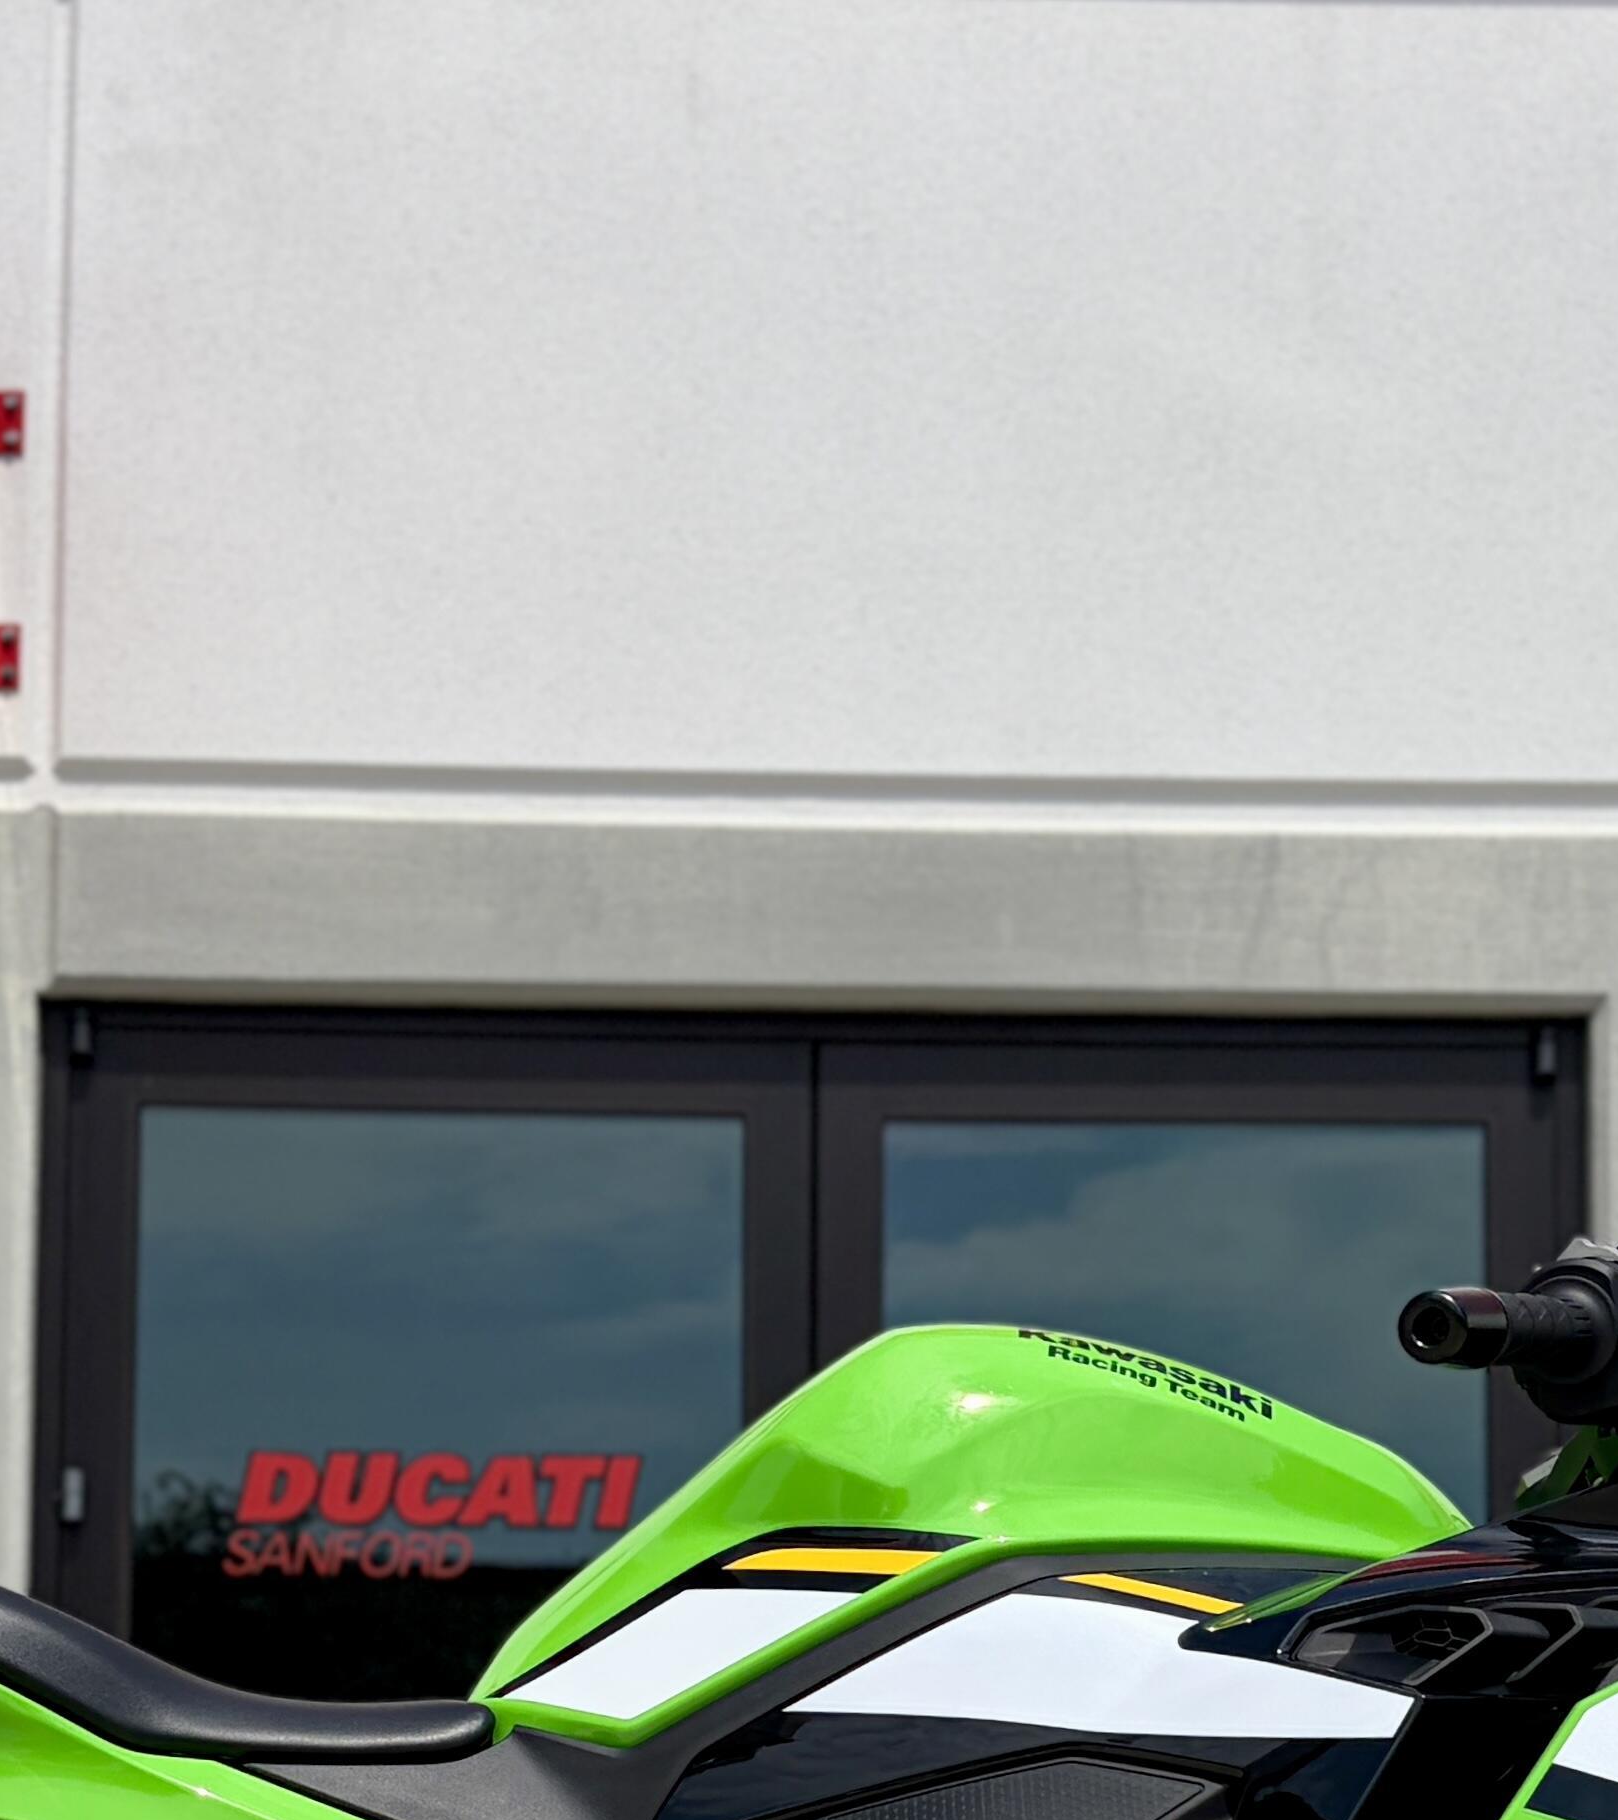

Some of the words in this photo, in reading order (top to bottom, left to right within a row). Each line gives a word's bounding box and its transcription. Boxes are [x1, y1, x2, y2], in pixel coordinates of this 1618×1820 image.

[1018, 1329, 1273, 1420] Kawasaki
[1047, 1345, 1157, 1388] Racing
[1163, 1377, 1246, 1422] Team
[235, 1450, 642, 1529] DUCATI
[221, 1529, 473, 1579] SANFORD
